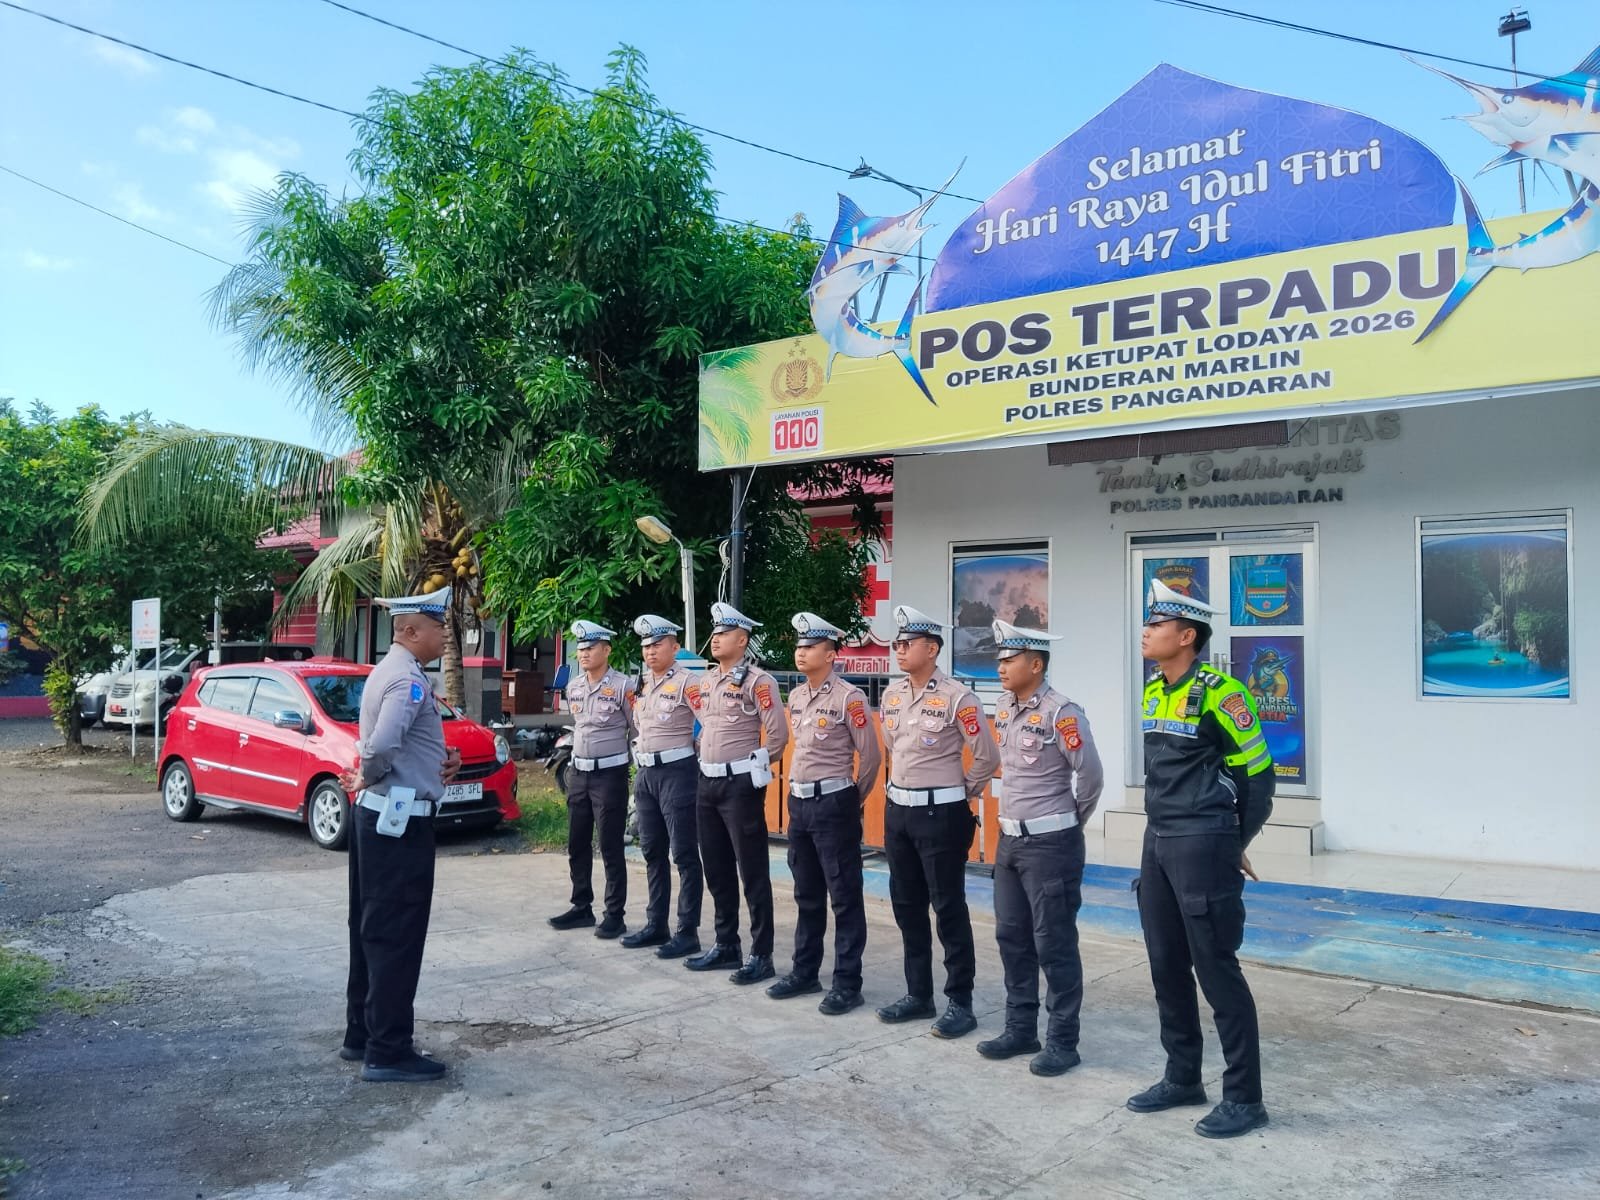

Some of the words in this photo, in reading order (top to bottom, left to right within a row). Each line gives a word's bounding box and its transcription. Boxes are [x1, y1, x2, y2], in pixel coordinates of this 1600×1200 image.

[1086, 128, 1246, 191] Selamat
[973, 206, 1058, 255] Hari
[1068, 189, 1169, 228] Raya
[1179, 159, 1268, 205] Idul
[1280, 138, 1381, 185] Fitri
[1095, 227, 1180, 266] 1447
[1186, 201, 1237, 253] H
[919, 312, 1051, 370] POS
[1071, 246, 1456, 347] TERPADU
[946, 358, 1057, 388] OPERASI
[1066, 340, 1188, 372] KETUPAT
[1197, 322, 1319, 355] LODAYA
[1329, 310, 1416, 338] 2026
[1029, 365, 1175, 398] BUNDERAN
[1184, 349, 1301, 380] MARLIN
[1005, 397, 1104, 423] POLRES
[1111, 370, 1332, 411] PANGANDARAN
[776, 421, 817, 447] 110
[1256, 411, 1401, 451] NTAS
[1110, 496, 1182, 514] POLRES
[1189, 487, 1343, 509] PANGANDARAN
[846, 659, 879, 673] Merah
[659, 693, 676, 701] POLRI
[722, 692, 744, 700] POLRI
[1255, 696, 1290, 706] OLRES
[815, 708, 838, 717] POLRI
[921, 708, 945, 718] POLRI
[1021, 725, 1045, 736] POLRI
[1167, 722, 1194, 733] POLRI
